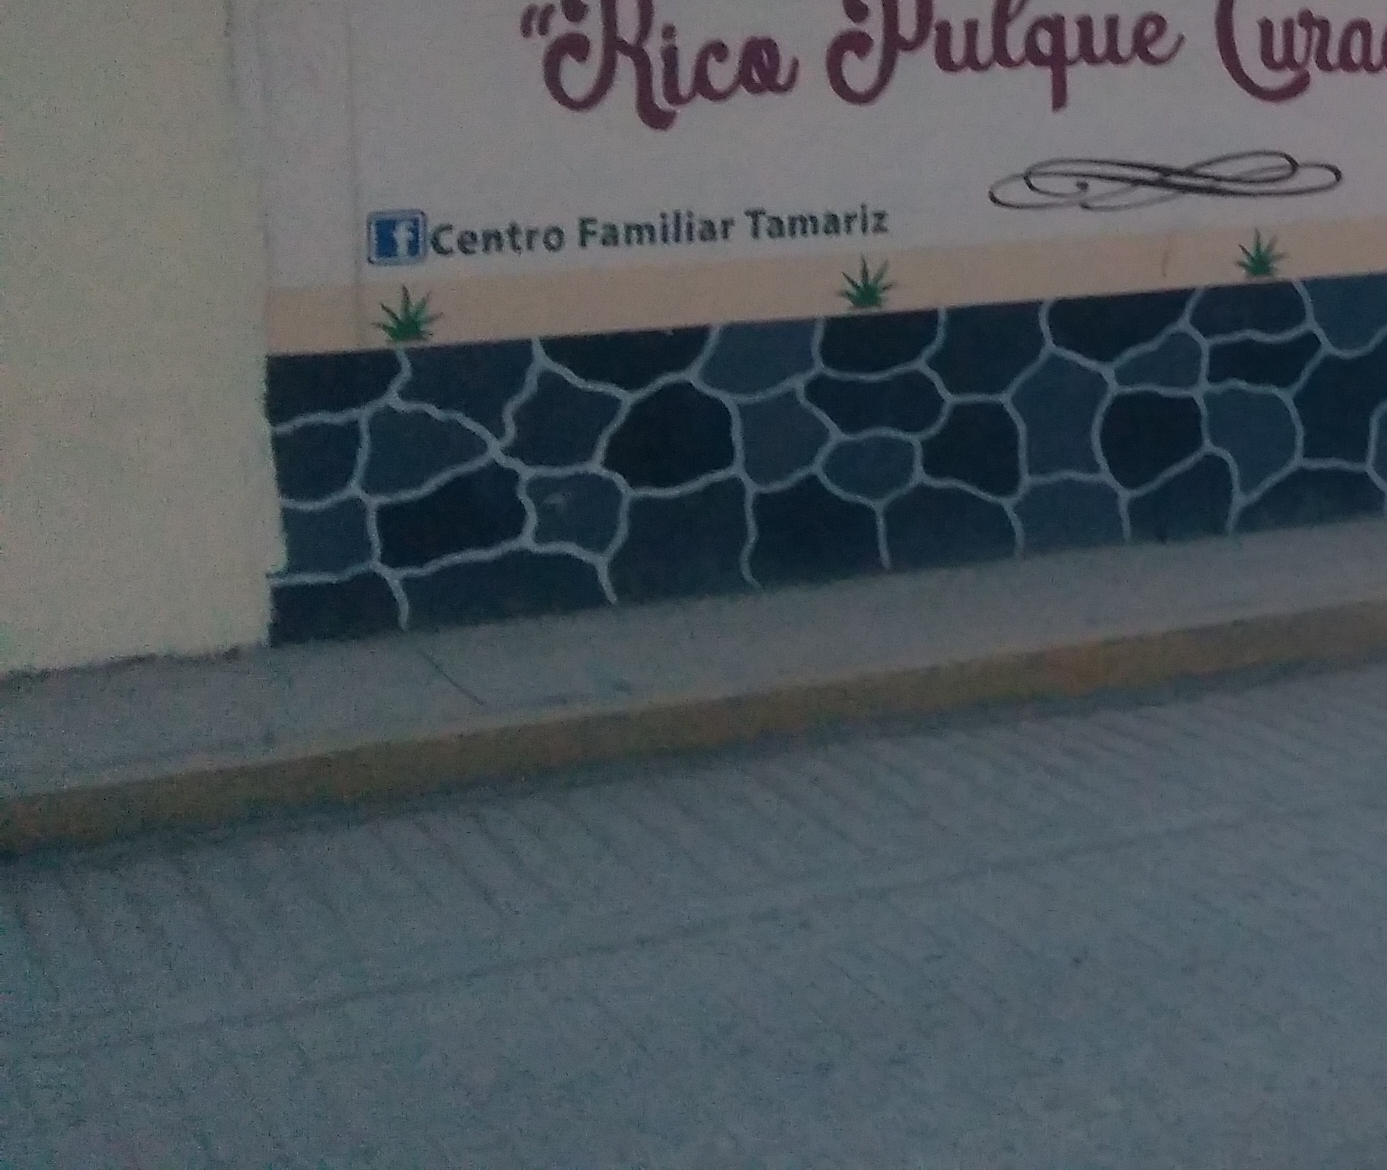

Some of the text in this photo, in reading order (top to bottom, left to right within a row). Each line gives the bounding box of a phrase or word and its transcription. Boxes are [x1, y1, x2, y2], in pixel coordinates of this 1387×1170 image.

[429, 221, 566, 256] Centro
[577, 213, 736, 250] Familiar
[745, 203, 891, 240] Tamariz
